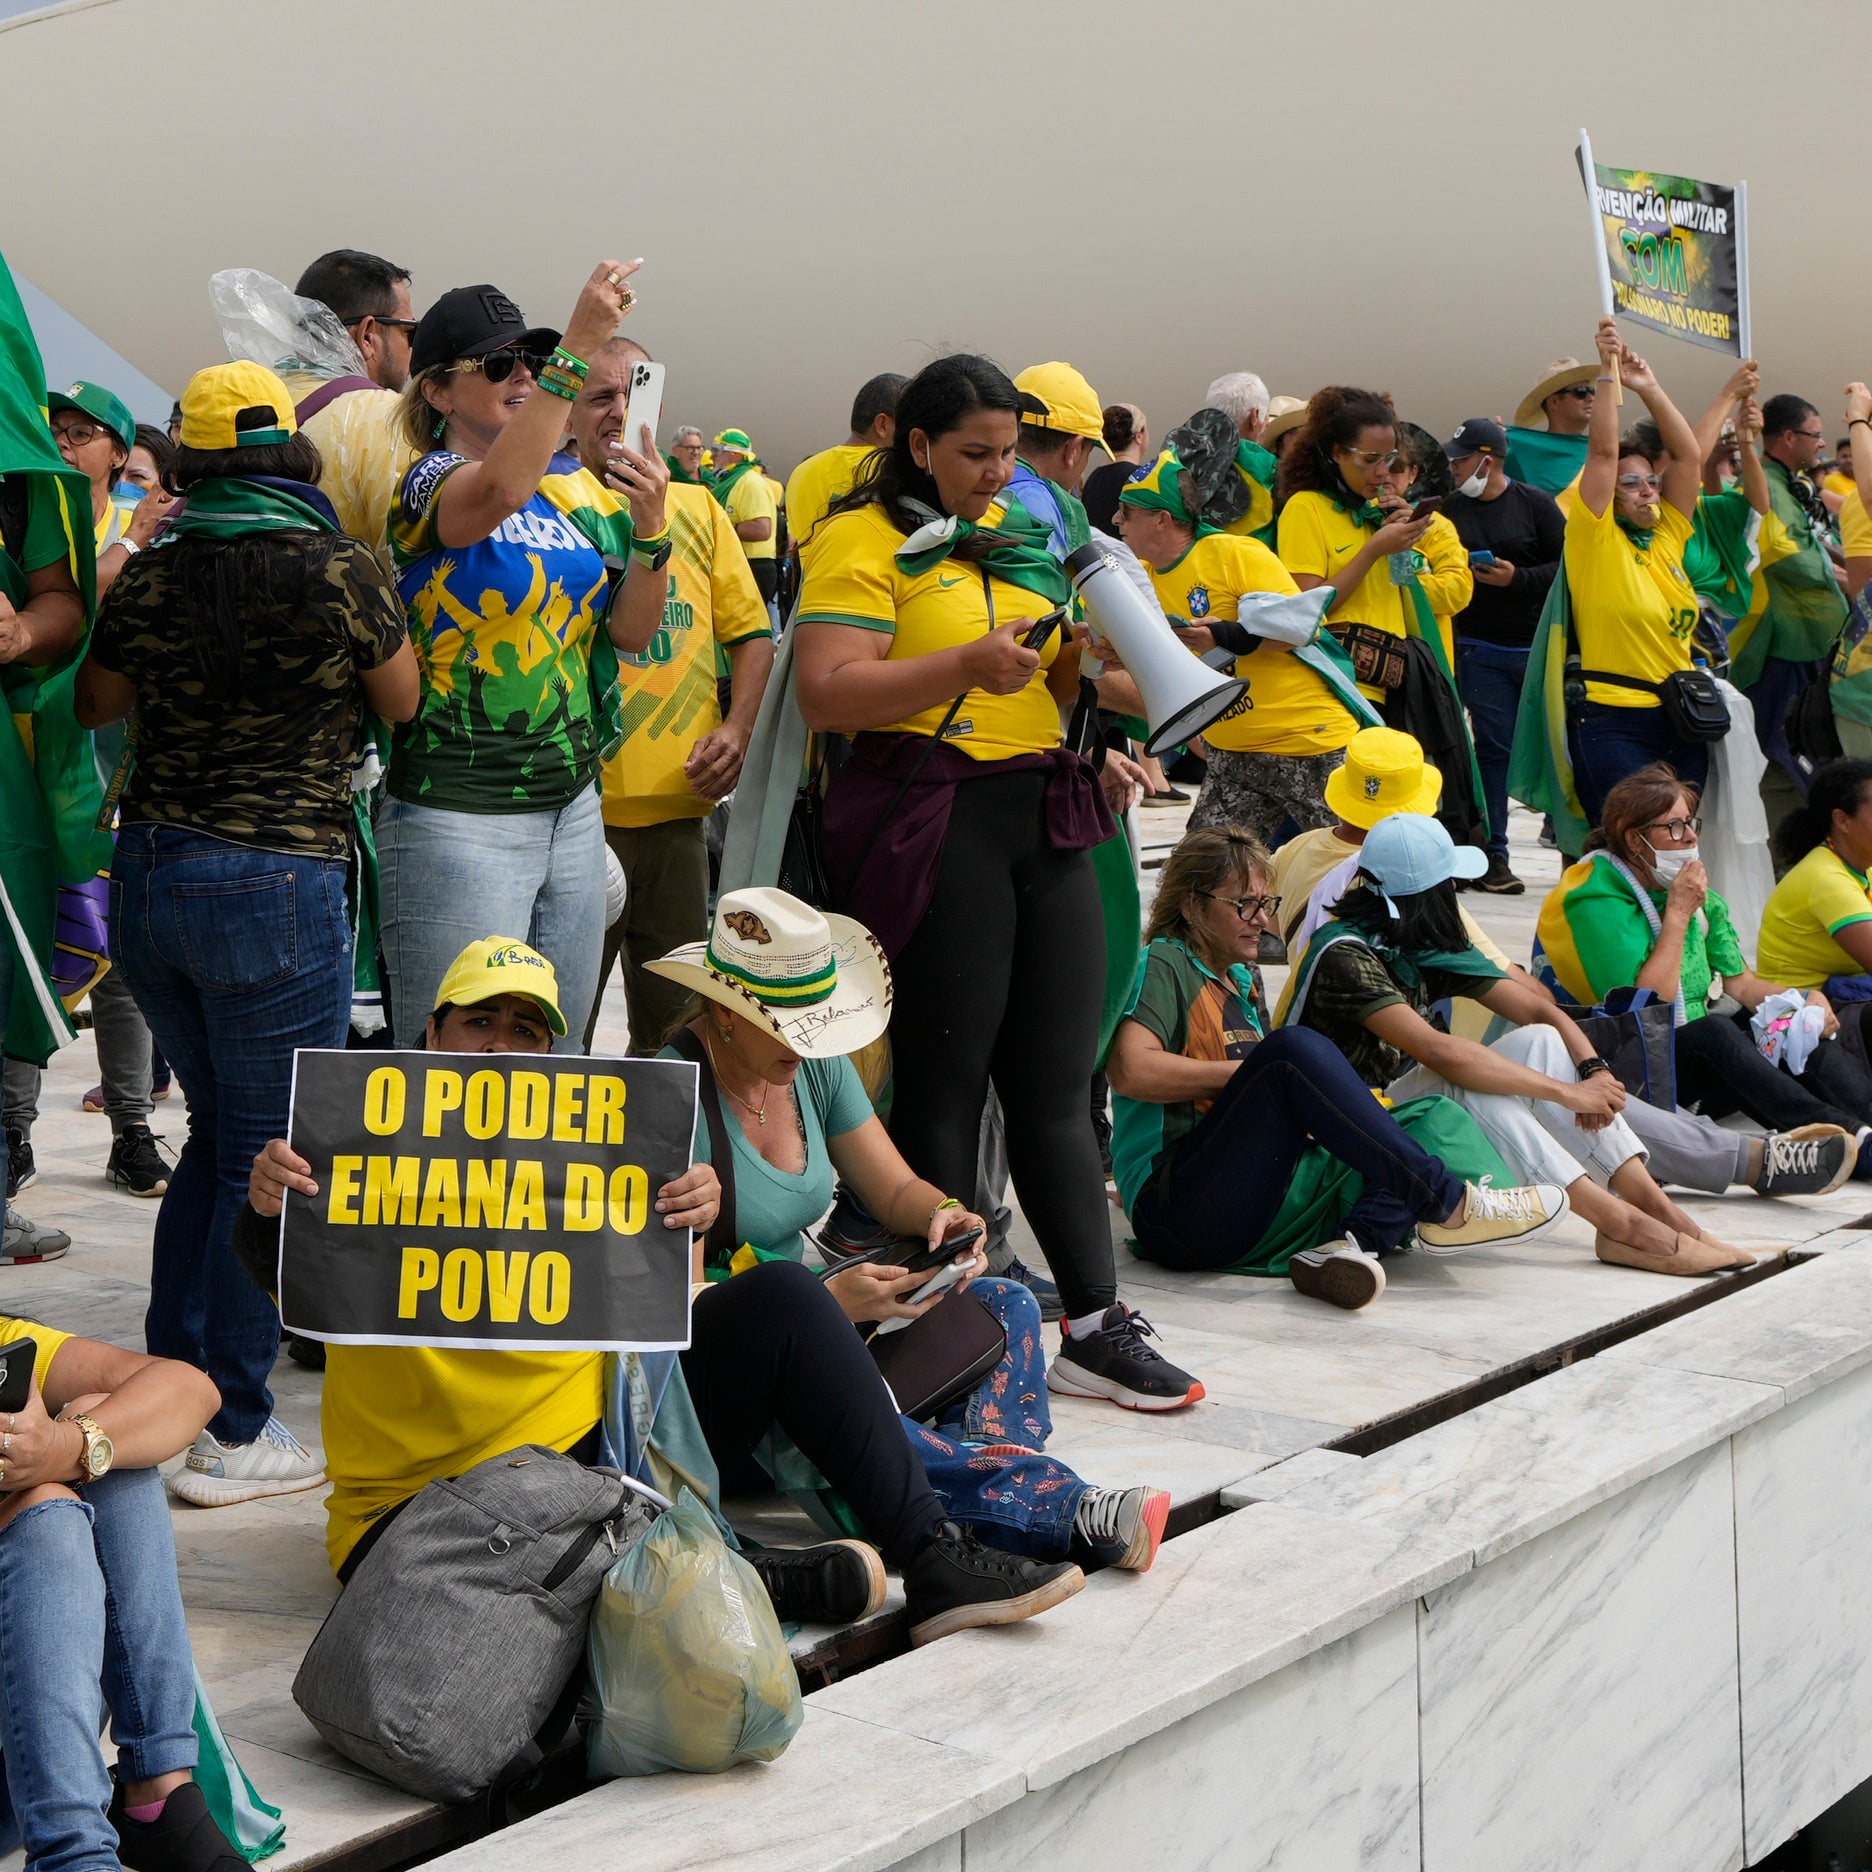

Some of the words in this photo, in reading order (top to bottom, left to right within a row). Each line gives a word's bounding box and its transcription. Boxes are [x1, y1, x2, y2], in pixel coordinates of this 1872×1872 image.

[1669, 198, 1728, 235] MILITAR
[1668, 302, 1687, 330] NO
[1685, 306, 1731, 340] PODER!
[363, 1066, 406, 1136] O
[422, 1069, 627, 1144] PODER
[327, 1155, 547, 1231] EMANA
[563, 1163, 649, 1236] DO
[397, 1247, 571, 1325] POVO
